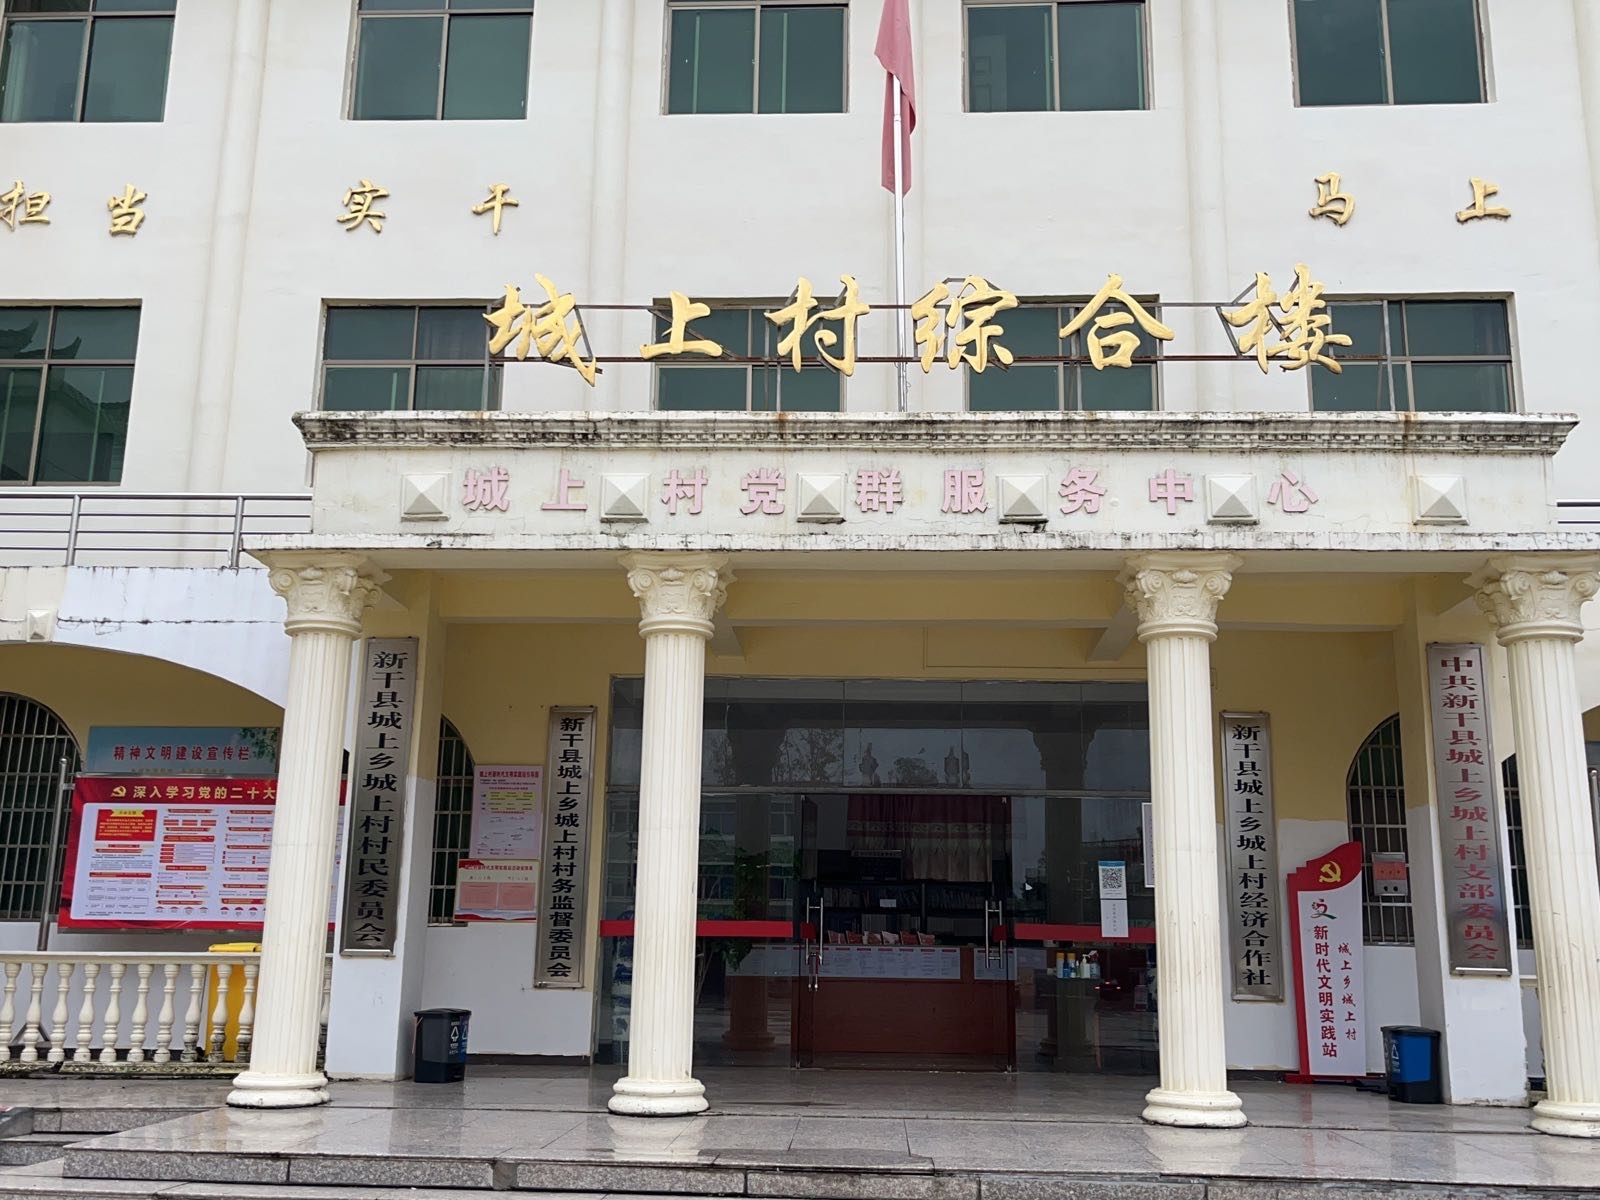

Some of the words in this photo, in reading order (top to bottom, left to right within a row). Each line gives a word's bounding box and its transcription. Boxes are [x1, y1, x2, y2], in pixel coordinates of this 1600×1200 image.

[0, 180, 148, 236] 担当
[336, 179, 519, 236] 实干
[1308, 171, 1512, 227] 马上
[484, 263, 1353, 387] 城上村综合楼
[462, 466, 1319, 516] 城上村党群服务中心
[113, 745, 250, 760] 精神文明建设宣传栏
[133, 785, 275, 800] 深入学习党的二十大
[352, 651, 409, 943] 新干县城上乡城上村村民委员会
[1440, 656, 1499, 960] 中共新干县城上乡城上村支部委员会
[547, 717, 585, 978] 新干县城上乡城上村村务监督委员会
[1231, 724, 1272, 986] 新干县城上乡城上村经济合作社
[1313, 925, 1337, 1058] 新时代文明实践站
[1338, 942, 1357, 1042] 城上乡城上村
